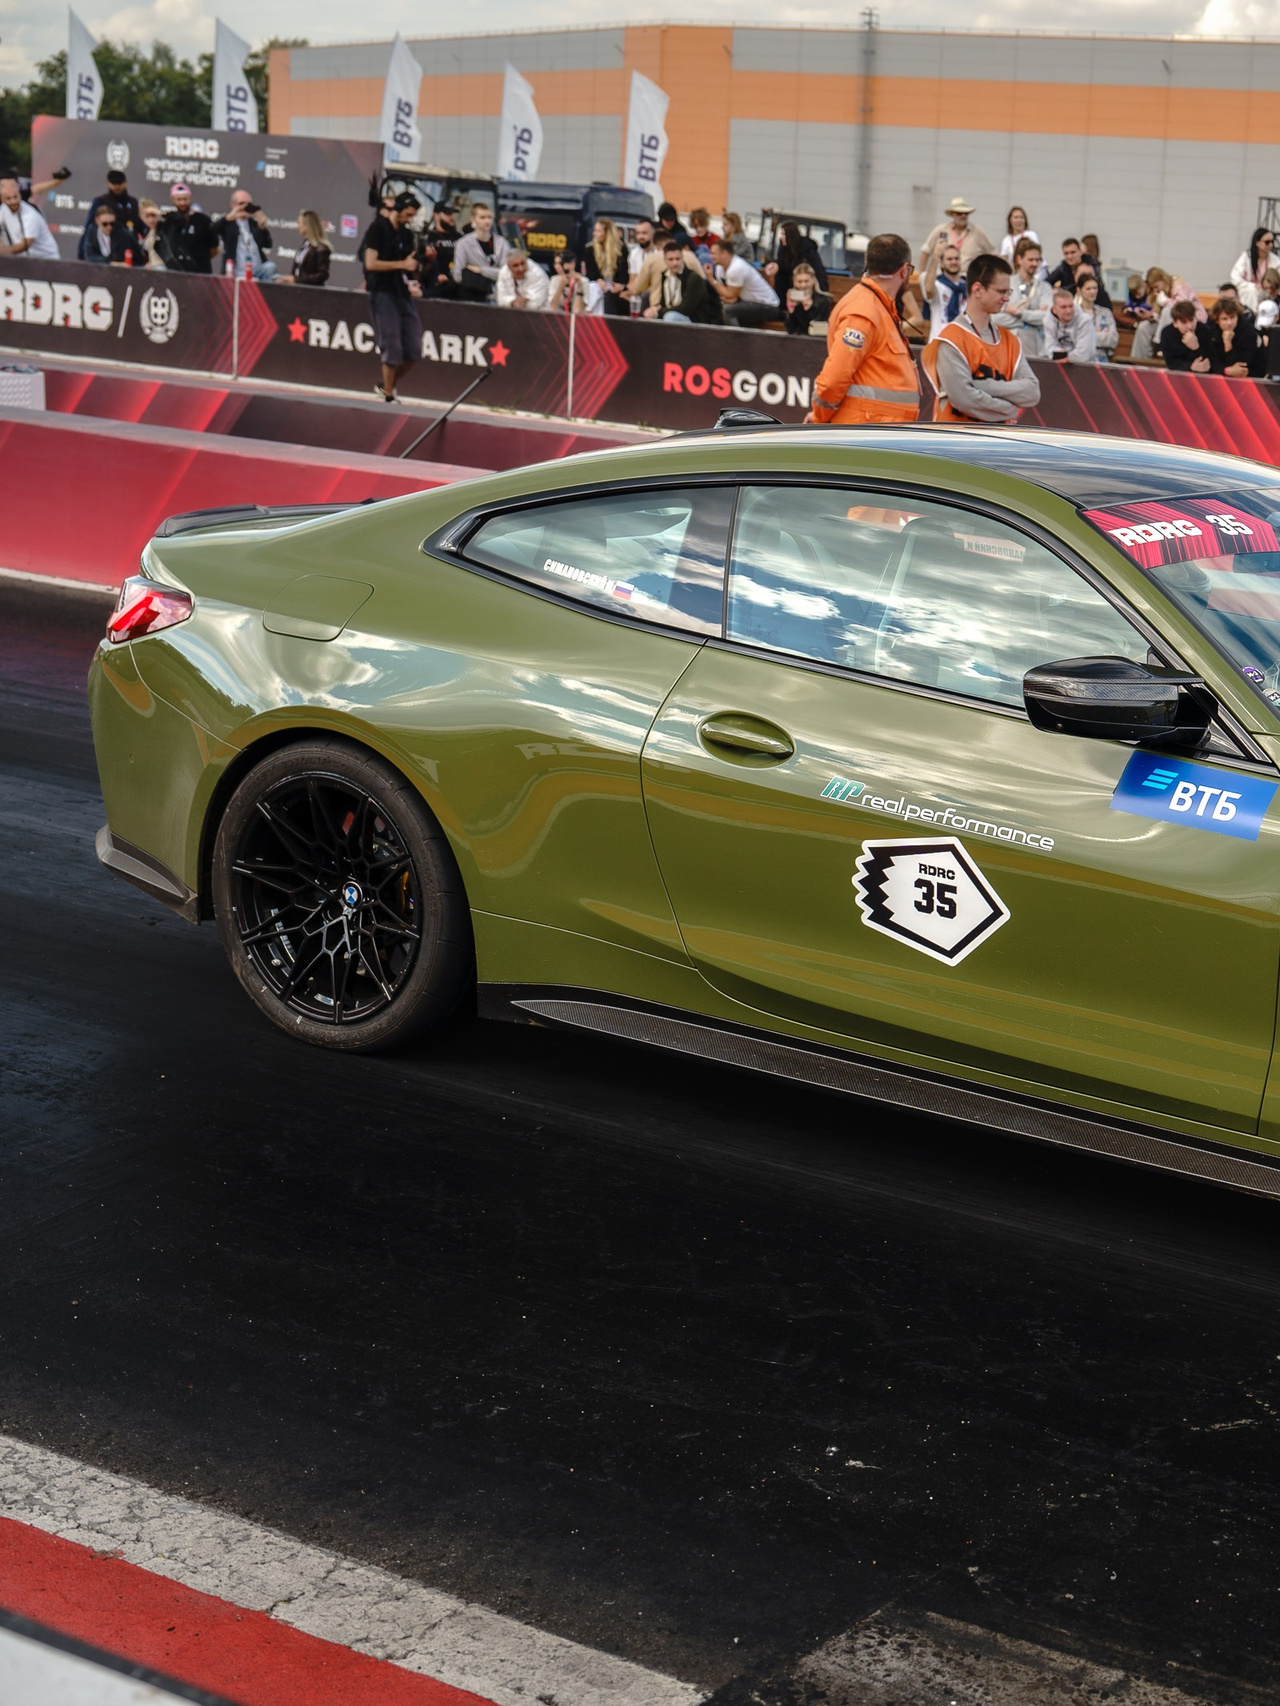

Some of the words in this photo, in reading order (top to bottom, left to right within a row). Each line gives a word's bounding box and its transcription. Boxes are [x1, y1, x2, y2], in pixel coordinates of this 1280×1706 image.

[225, 83, 249, 132] ВТБ
[393, 98, 414, 148] ВТБ
[165, 135, 220, 159] RDRC
[637, 133, 660, 182] ВТБ
[0, 277, 114, 332] RDRC
[308, 318, 489, 368] RACARK
[663, 362, 812, 408] ROSGON
[1107, 519, 1203, 547] RDRC
[1205, 514, 1254, 536] 35
[820, 775, 866, 801] RP
[861, 797, 1055, 850] real.performance
[1168, 780, 1243, 822] ВТБ
[918, 862, 956, 881] RDRC
[913, 877, 958, 920] 35
